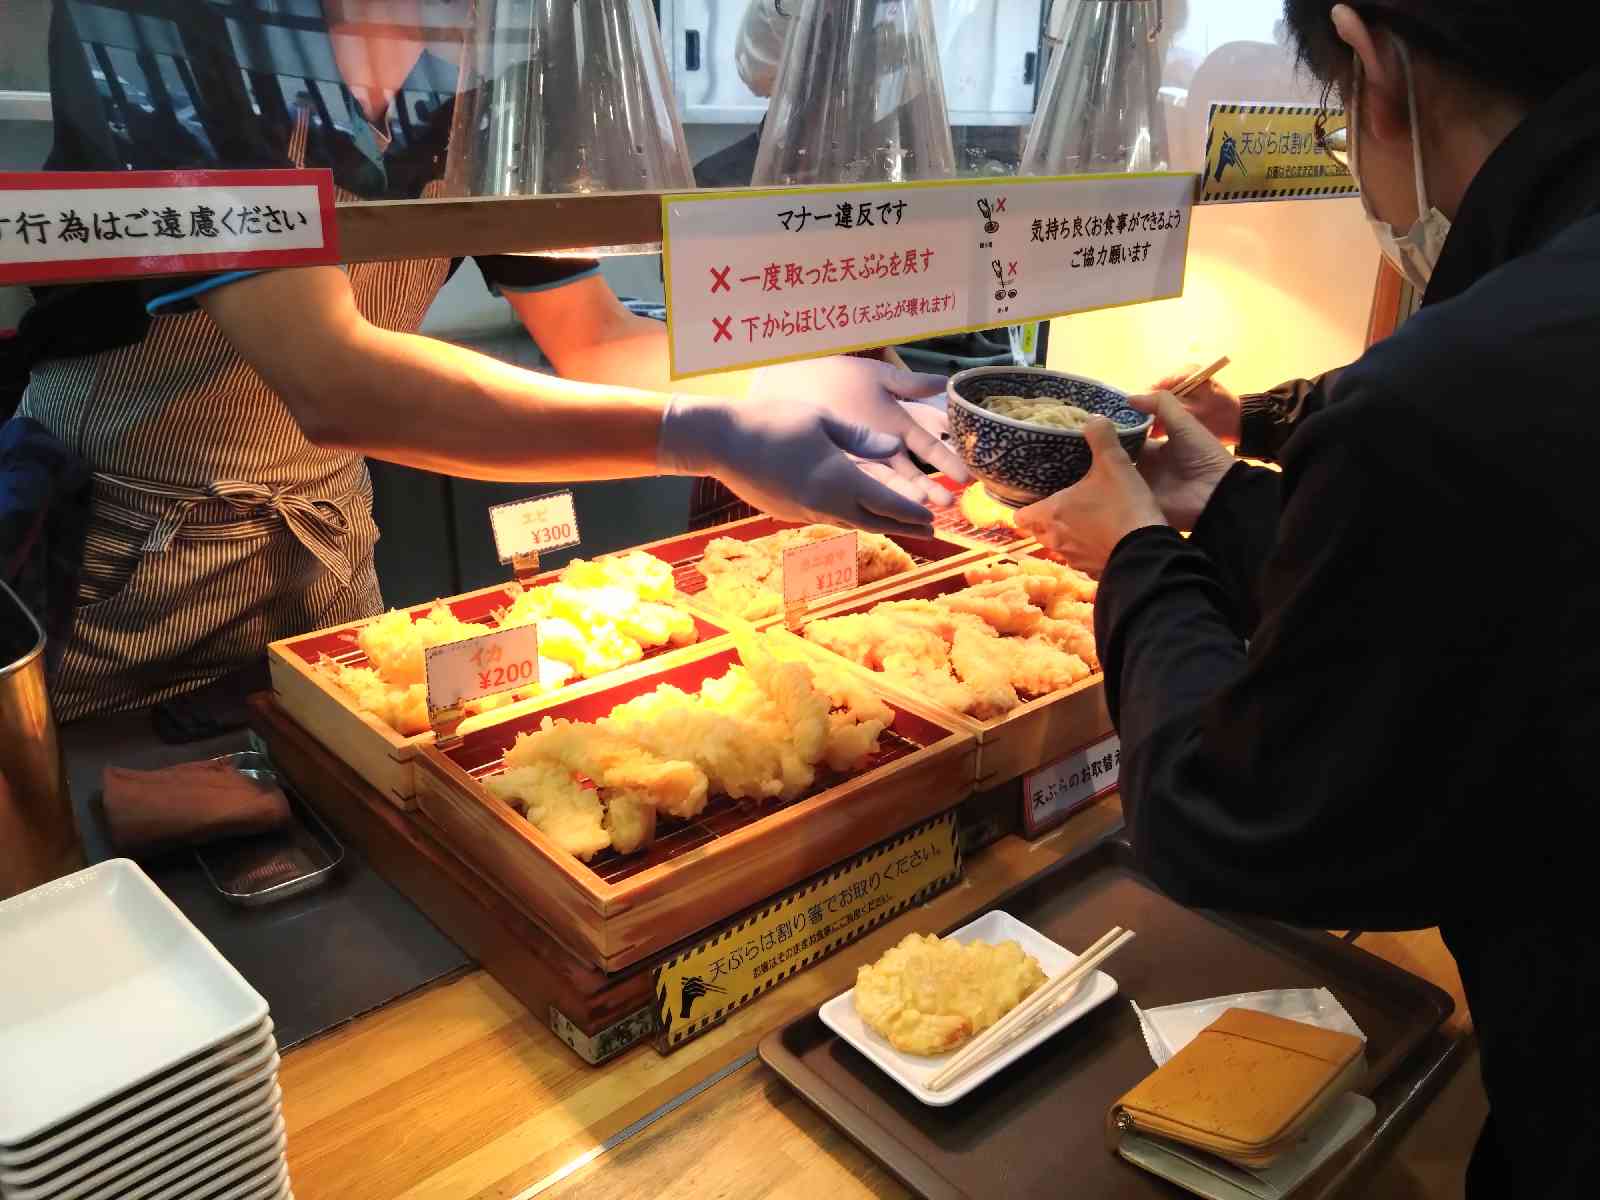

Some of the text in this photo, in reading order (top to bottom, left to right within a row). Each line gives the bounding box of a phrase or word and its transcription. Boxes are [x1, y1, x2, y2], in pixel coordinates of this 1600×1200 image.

[776, 199, 909, 232] マナー違反です
[1029, 208, 1182, 242] 気持ち良くお食事ができるよう
[739, 247, 935, 292] 一度取った天ぷらを戻す
[1070, 240, 1152, 269] ご協力願います
[531, 523, 572, 545] ¥300
[815, 566, 852, 591] ¥120
[477, 659, 533, 690] ¥200
[708, 842, 943, 982] 天ぷらは割り箸でお取りください。
